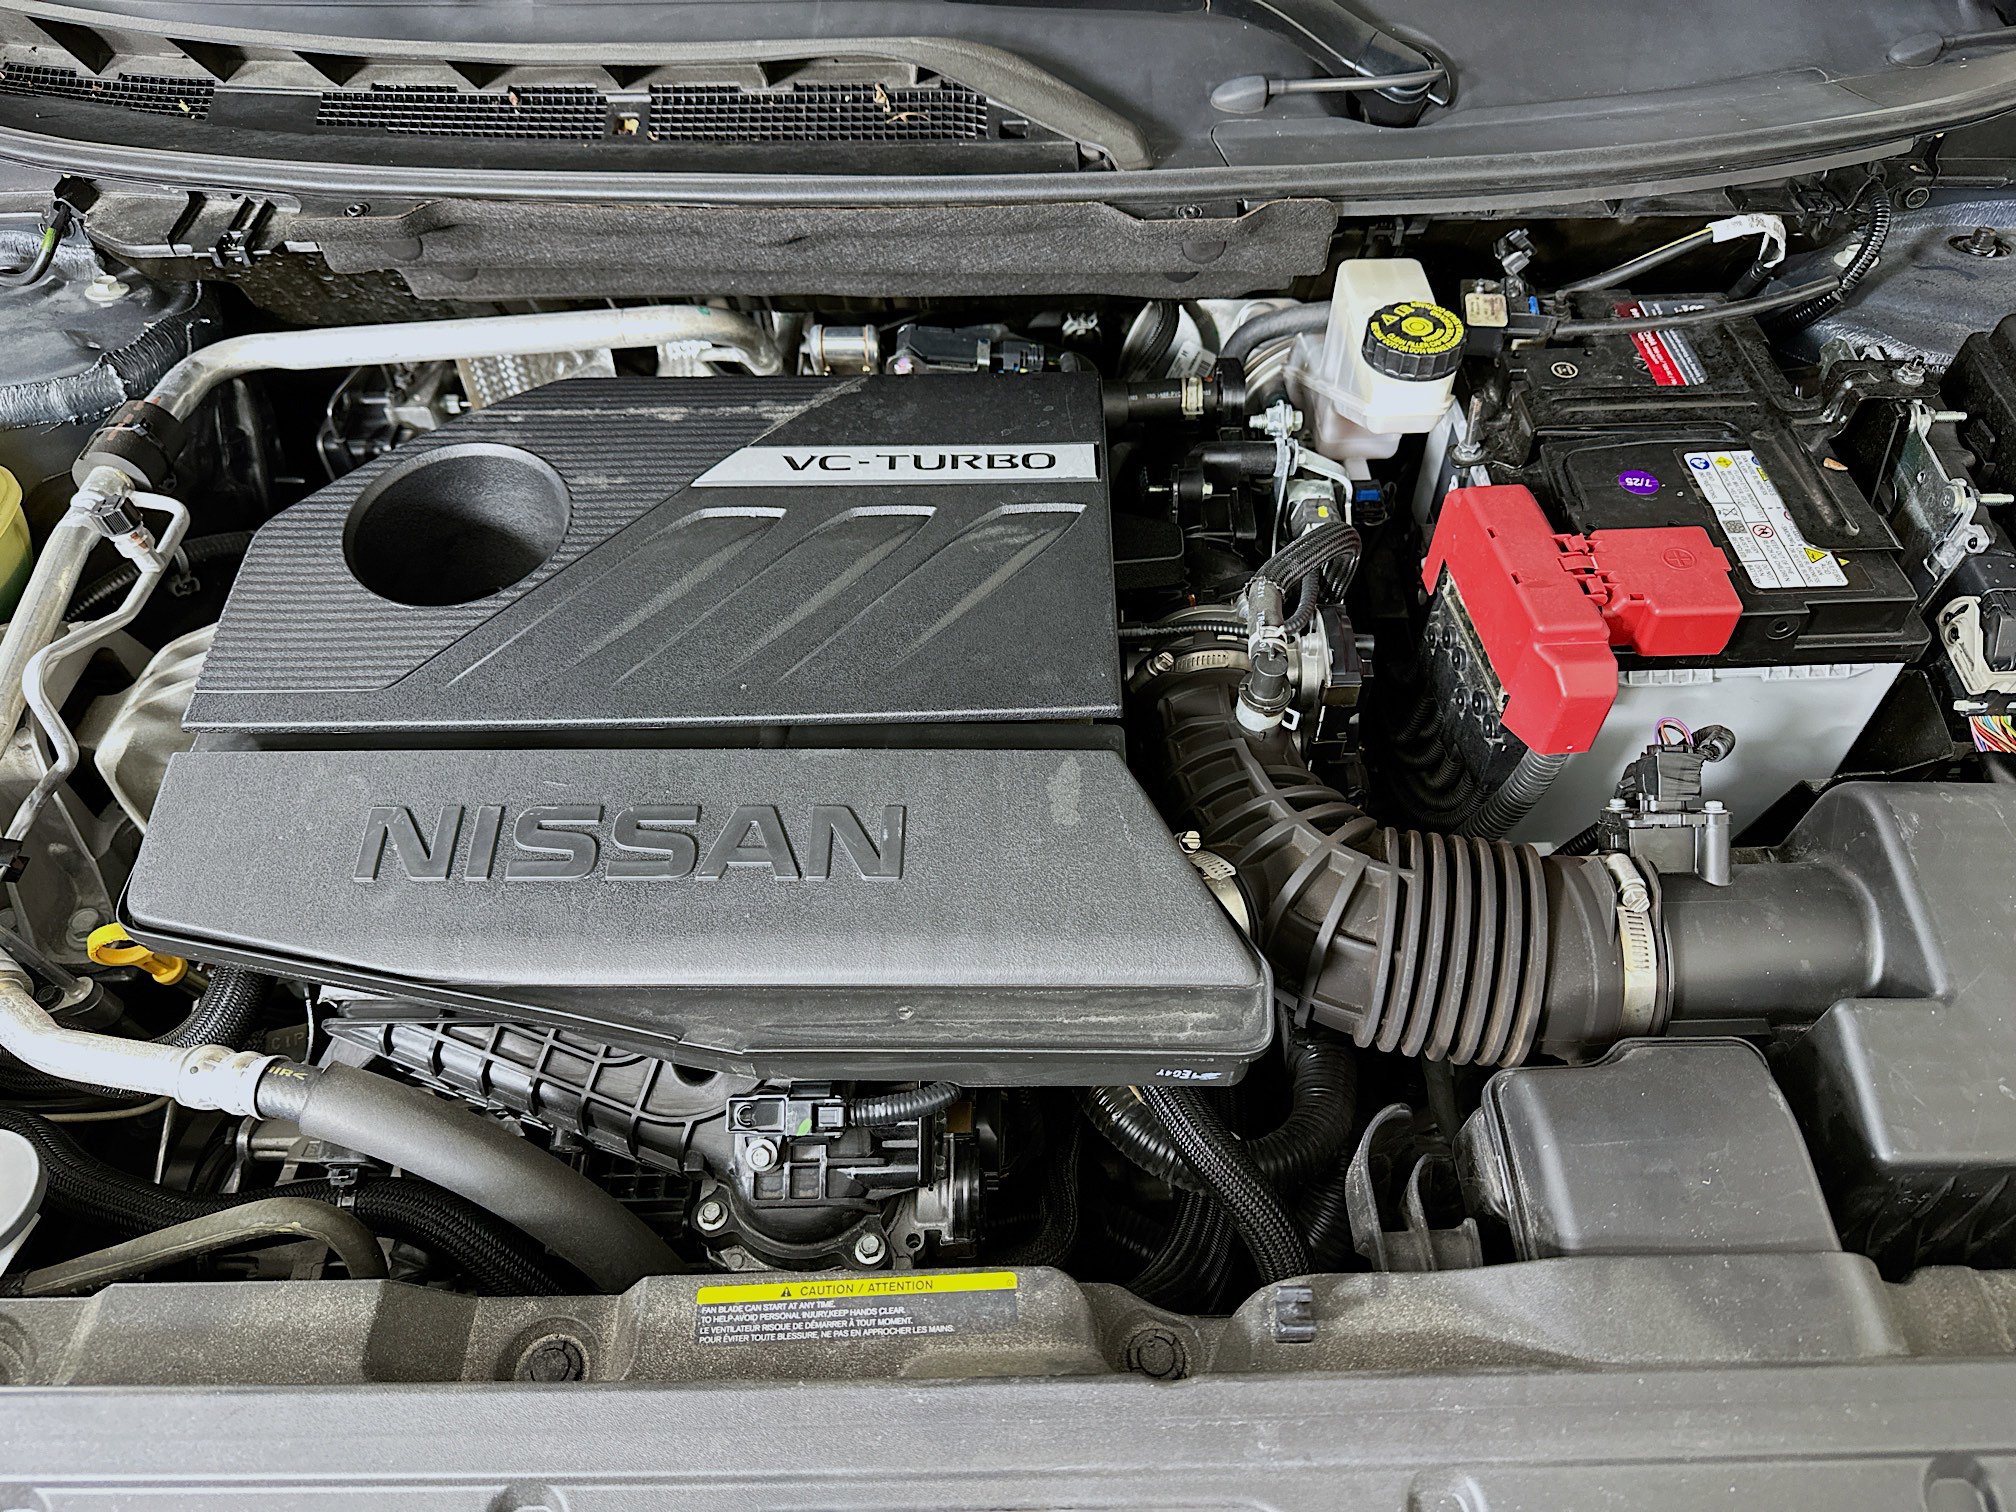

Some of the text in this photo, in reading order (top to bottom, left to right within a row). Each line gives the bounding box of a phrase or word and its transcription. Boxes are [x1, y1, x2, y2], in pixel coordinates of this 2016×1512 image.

[782, 452, 1056, 471] VC-TURBO
[1624, 476, 1652, 488] 7/25
[353, 805, 907, 881] NISSAN
[800, 1284, 854, 1296] CAUTION
[868, 1280, 933, 1292] ATTENTION
[701, 1316, 712, 1324] TO
[713, 1314, 733, 1324] HELP
[734, 1313, 758, 1323] AVOID
[760, 1312, 800, 1321] PERSONAL
[850, 1308, 877, 1317] HANDS
[879, 1307, 906, 1315] CLEAR.
[702, 1300, 836, 1314] FAN BLADE CAN START AT ANY TIME.
[711, 1324, 760, 1334] VENTILATEUR
[762, 1322, 790, 1332] RISQUE
[793, 1322, 803, 1330] DE
[805, 1319, 847, 1330] DÉMARRER
[849, 1318, 855, 1327] À
[856, 1318, 876, 1326] TOUT
[878, 1317, 913, 1326] MOMENT.
[699, 1335, 722, 1344] POUR
[723, 1334, 749, 1343] ÉVITER
[751, 1333, 776, 1341] TOUTE
[777, 1331, 819, 1340] BLESSURE,
[862, 1327, 911, 1336] APPROCHER
[912, 1326, 927, 1334] LES
